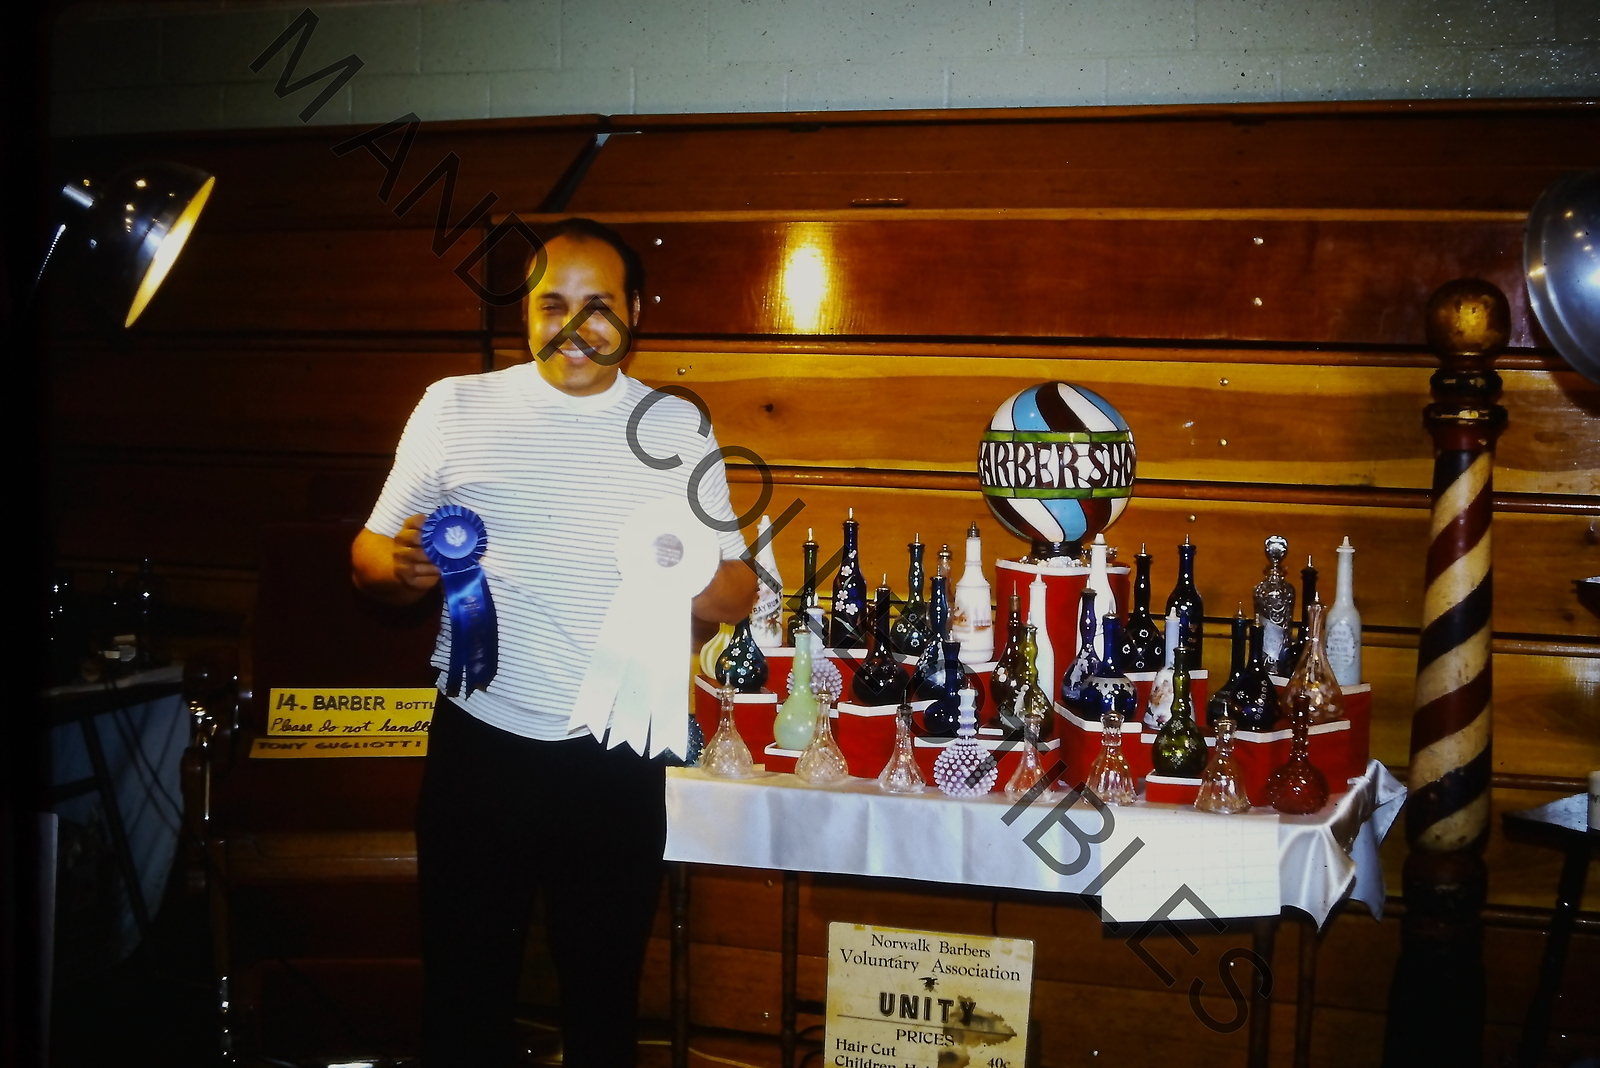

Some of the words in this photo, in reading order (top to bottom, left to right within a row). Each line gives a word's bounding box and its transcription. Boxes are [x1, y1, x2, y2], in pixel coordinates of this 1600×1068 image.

[978, 441, 1080, 489] ARBER
[753, 604, 767, 615] BAY
[313, 695, 386, 711] BARBER
[270, 717, 313, 732] Please
[318, 719, 339, 732] do
[342, 720, 374, 733] not
[258, 742, 308, 750] TONY
[314, 740, 421, 749] GUGLIOTTI
[871, 933, 930, 953] Norwalk
[939, 940, 991, 959] Barbers
[840, 948, 919, 973] Voluntary
[931, 958, 1021, 981] Association
[878, 991, 977, 1026] UNITY
[895, 1028, 955, 1047] PRICES
[836, 1038, 868, 1053] Hair
[871, 1043, 896, 1057] Cut
